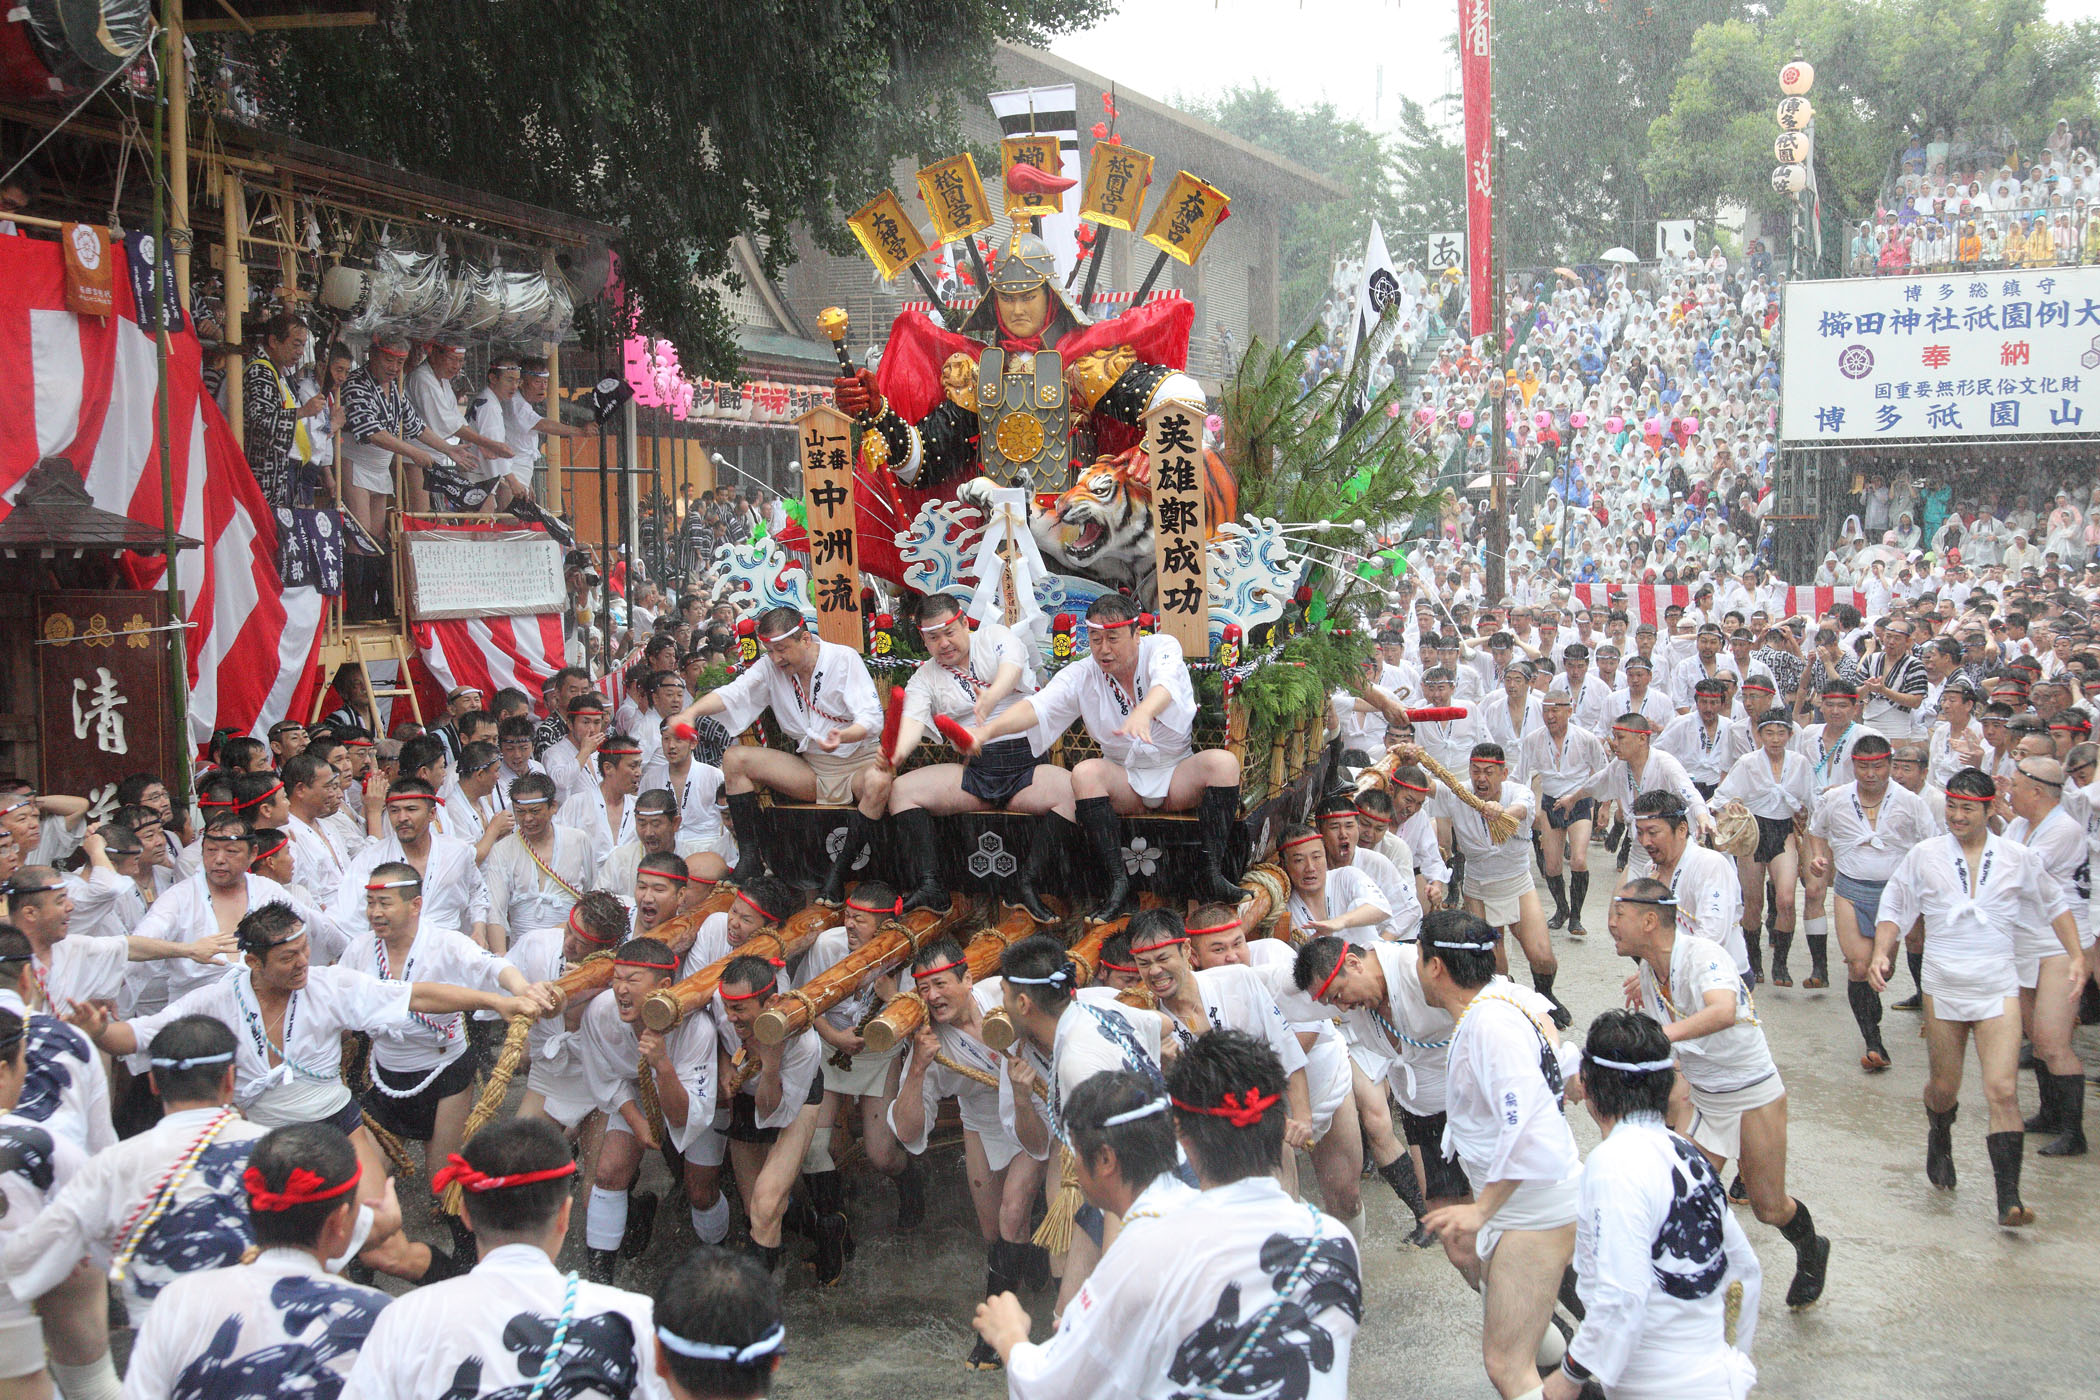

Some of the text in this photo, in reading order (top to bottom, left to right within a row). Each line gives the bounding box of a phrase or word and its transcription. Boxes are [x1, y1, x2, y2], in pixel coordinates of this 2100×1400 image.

[1433, 236, 1461, 266] あ
[1903, 277, 2056, 302] 博多総鎮守
[1921, 340, 2030, 369] 奉納
[1874, 375, 2081, 400] 国重要無形民俗文化財
[826, 434, 850, 470] 一番
[1156, 414, 1203, 615] 英雄鄭成功
[287, 532, 304, 582] 本部
[810, 479, 858, 612] 中洲流
[323, 541, 338, 590] 本部
